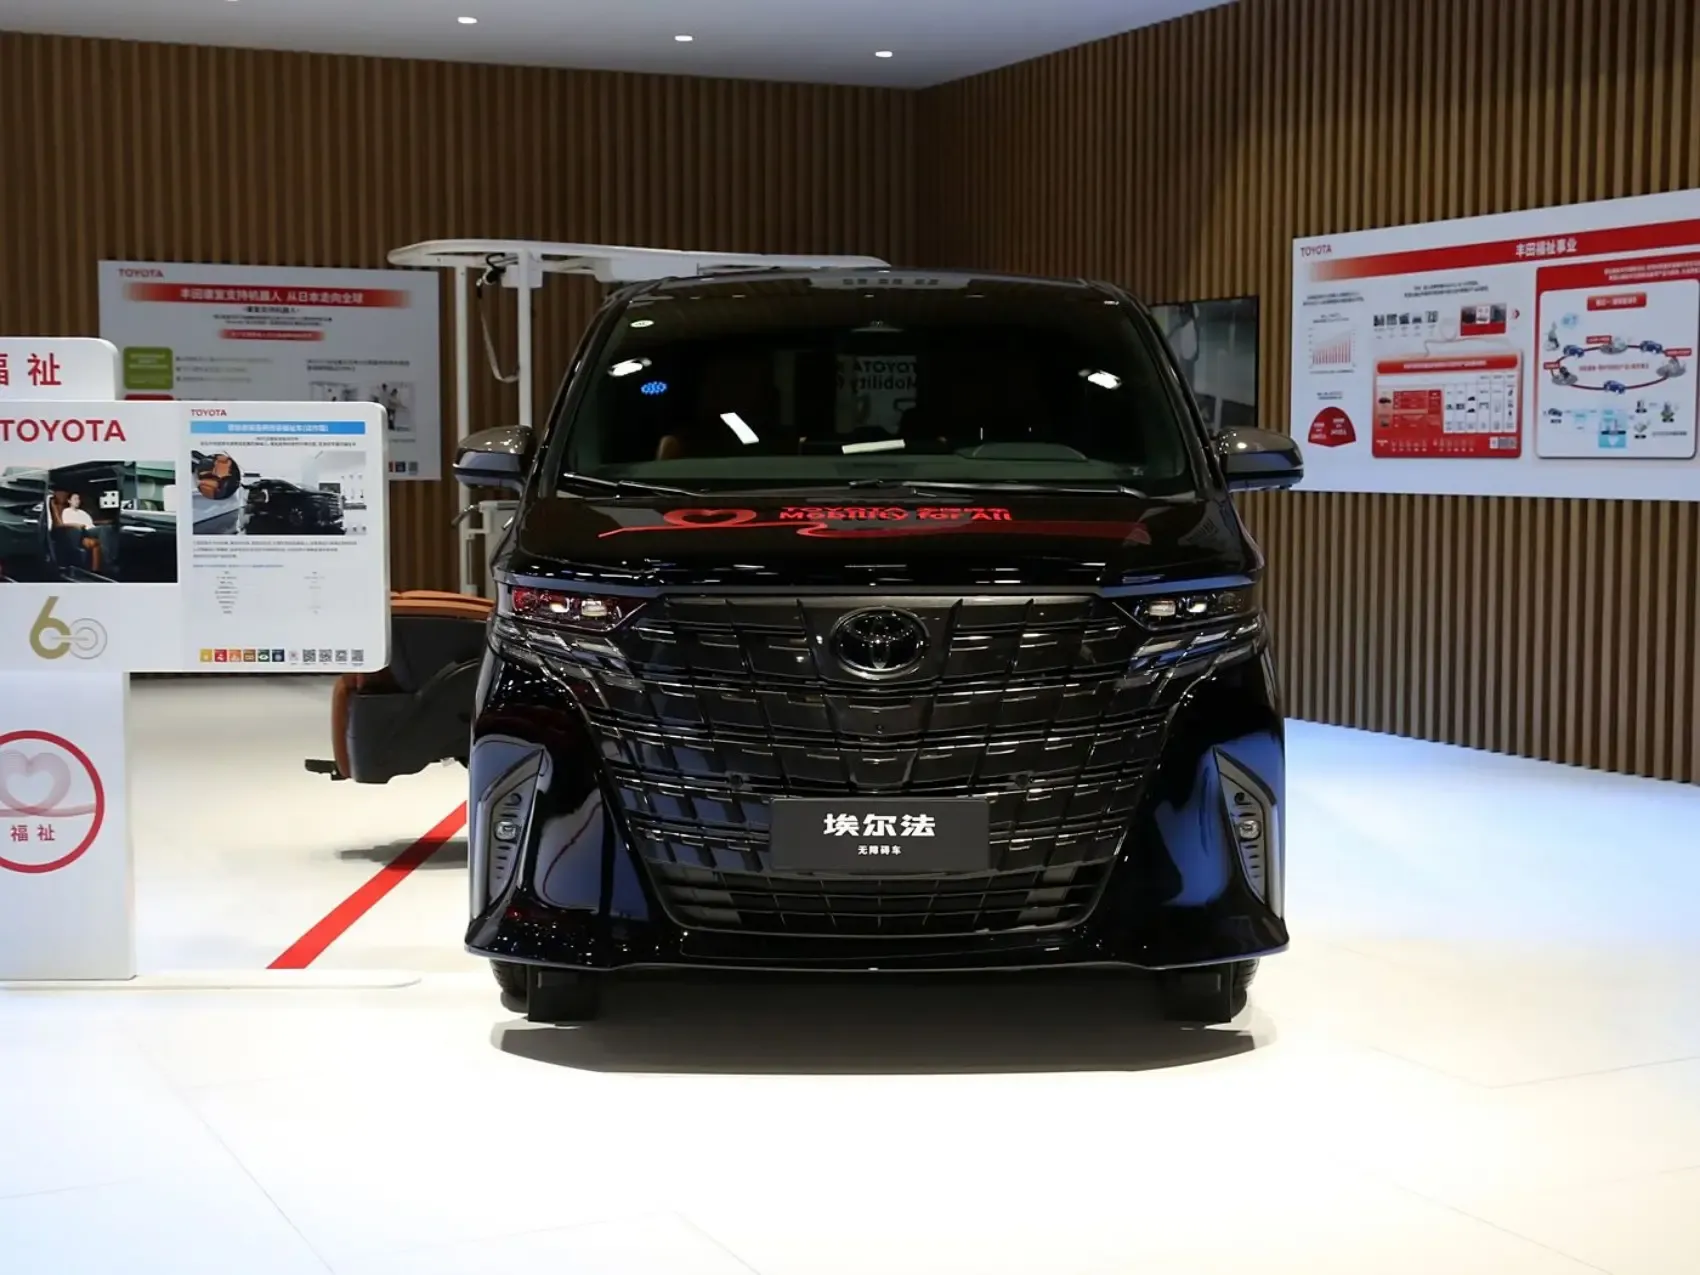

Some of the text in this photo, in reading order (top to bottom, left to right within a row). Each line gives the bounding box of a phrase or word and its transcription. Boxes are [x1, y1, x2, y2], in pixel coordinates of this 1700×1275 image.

[1300, 244, 1333, 257] TOYOTA
[118, 268, 164, 278] TOYOTA
[0, 353, 62, 386] 祉
[191, 409, 227, 417] TOYOTA
[0, 419, 126, 442] TOYOTA
[779, 510, 1012, 521] Mobility for All
[823, 813, 936, 837] 埃尔法
[10, 824, 55, 842] 福祉
[858, 845, 902, 856] 无障碍车
